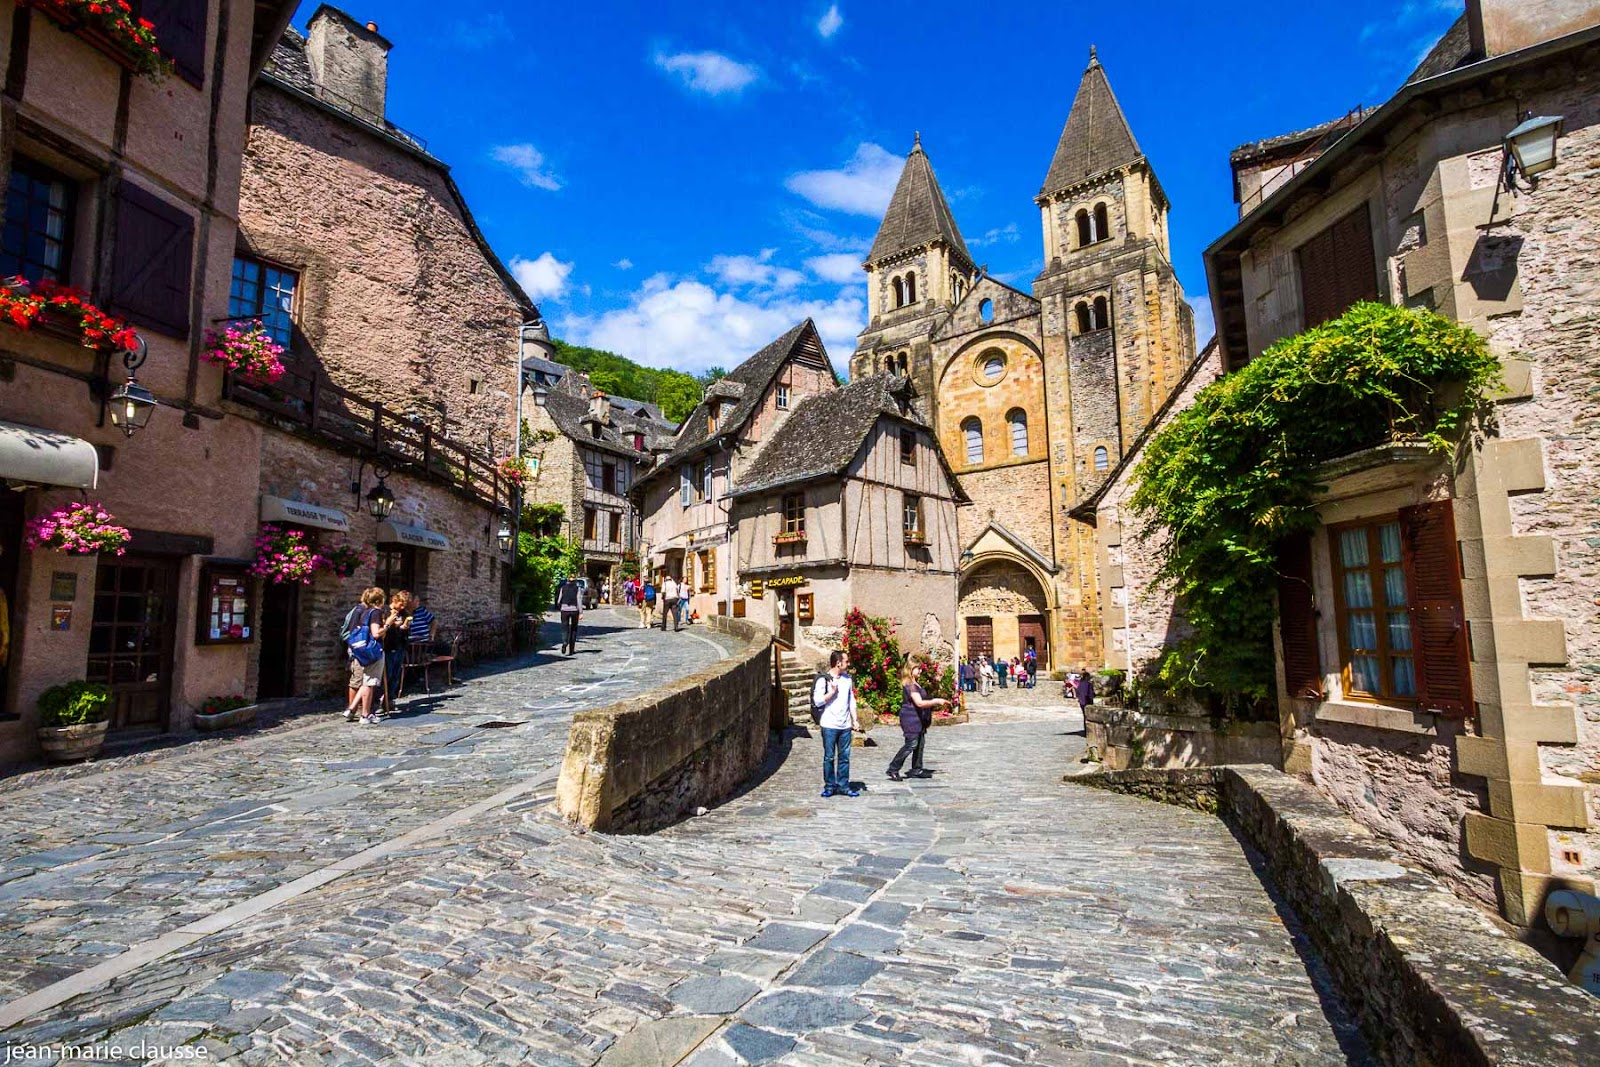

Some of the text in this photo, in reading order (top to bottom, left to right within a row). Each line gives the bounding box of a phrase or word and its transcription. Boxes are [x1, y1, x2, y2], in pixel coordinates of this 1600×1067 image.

[286, 507, 319, 520] TERRASSE
[401, 531, 424, 543] GLACIER
[768, 575, 804, 587] ESCAPADE
